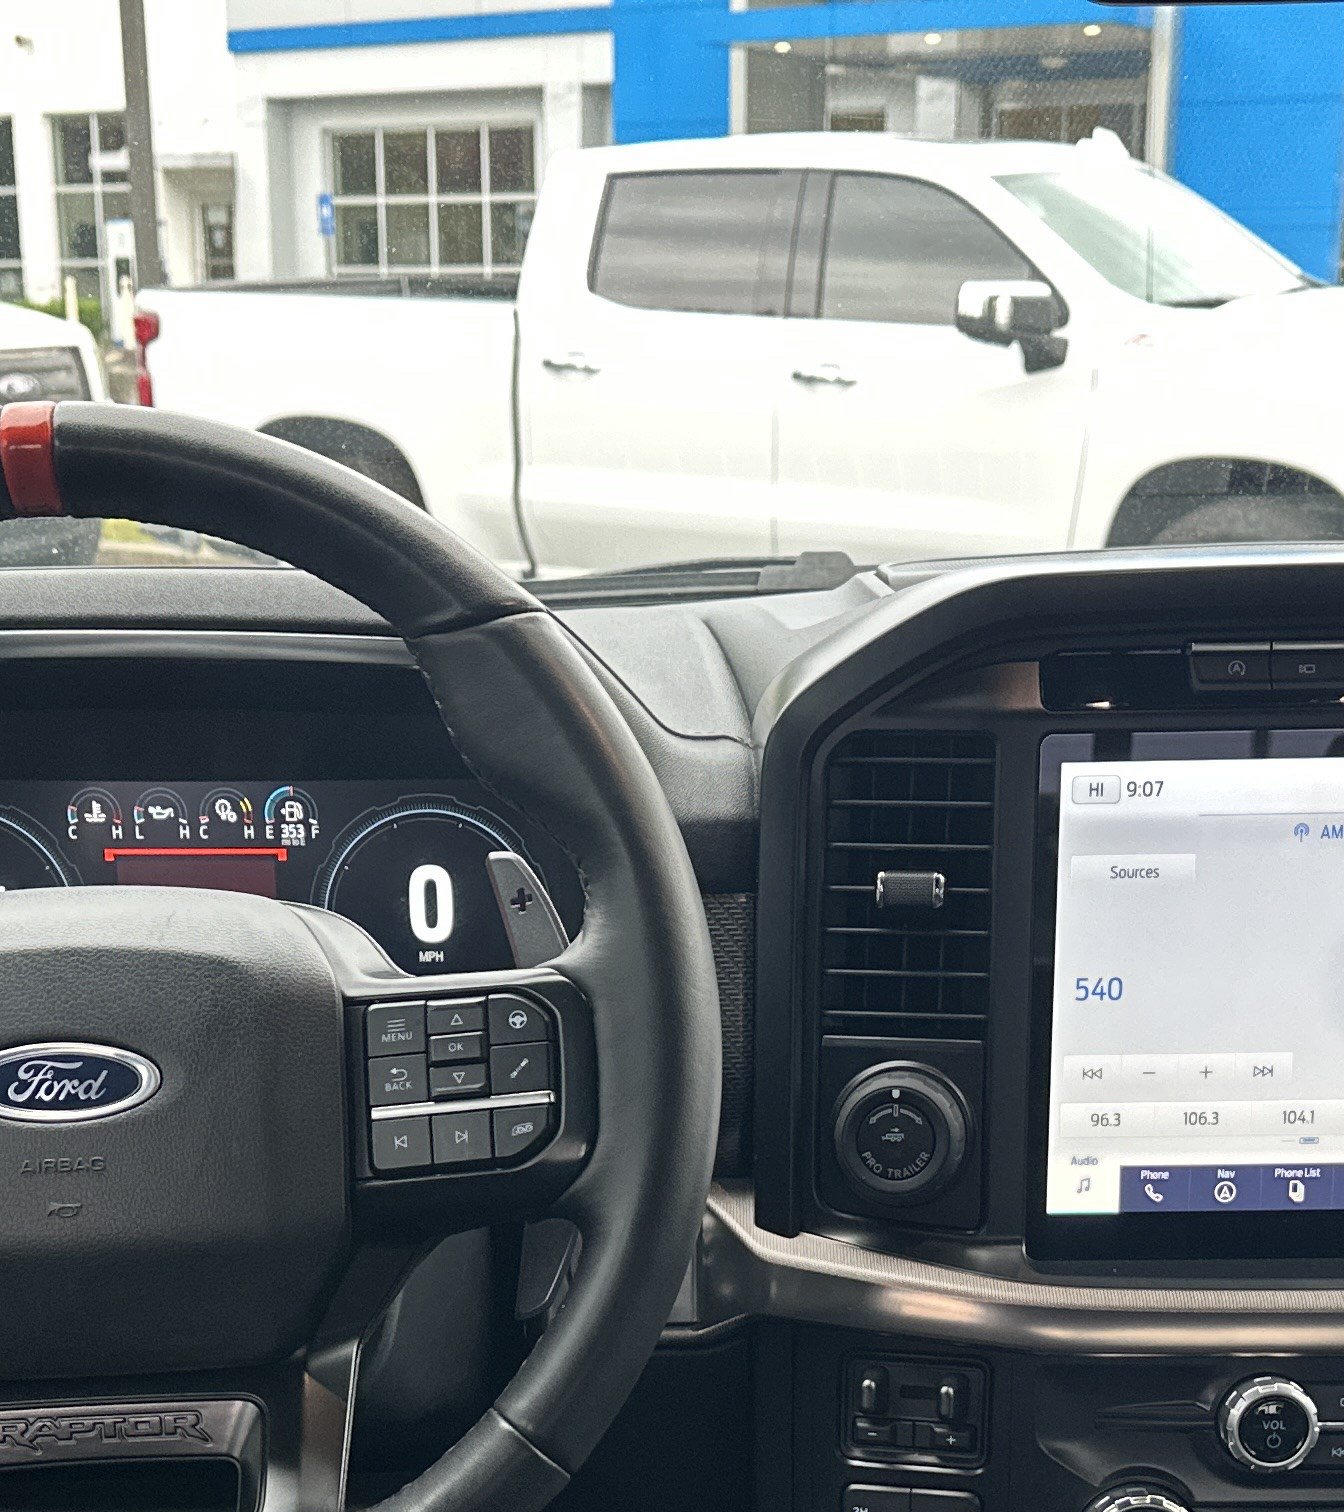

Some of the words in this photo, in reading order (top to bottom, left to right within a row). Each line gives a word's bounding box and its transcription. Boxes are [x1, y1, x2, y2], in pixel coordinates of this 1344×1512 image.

[1088, 782, 1104, 798] HI
[1126, 780, 1164, 798] 9:07
[68, 826, 78, 839] C
[112, 826, 123, 839] H
[135, 826, 145, 839] L
[179, 826, 190, 839] H
[199, 826, 209, 839] C
[244, 826, 255, 839] H
[265, 825, 275, 839] E
[280, 823, 306, 838] 353
[311, 825, 320, 839] F
[1319, 824, 1344, 840] AM
[1110, 864, 1160, 880] Sources
[408, 864, 455, 944] 0
[418, 950, 445, 963] MPH
[1074, 976, 1123, 1001] 540
[381, 1031, 413, 1043] MENU
[448, 1042, 464, 1053] OK
[7, 1059, 109, 1103] Ford
[384, 1080, 413, 1092] BACK
[1090, 1112, 1122, 1128] 96.3
[1183, 1111, 1219, 1126] 106.3
[1282, 1110, 1315, 1125] 104.1
[19, 1156, 107, 1175] AIRBAG
[862, 1151, 883, 1174] PRO
[887, 1151, 931, 1178] TRAILER
[1070, 1155, 1099, 1167] Audio
[1140, 1168, 1170, 1180] Phone
[1217, 1168, 1236, 1179] Nav
[1274, 1167, 1303, 1179] Phone
[1304, 1167, 1321, 1178] List
[1262, 1420, 1286, 1430] VOL
